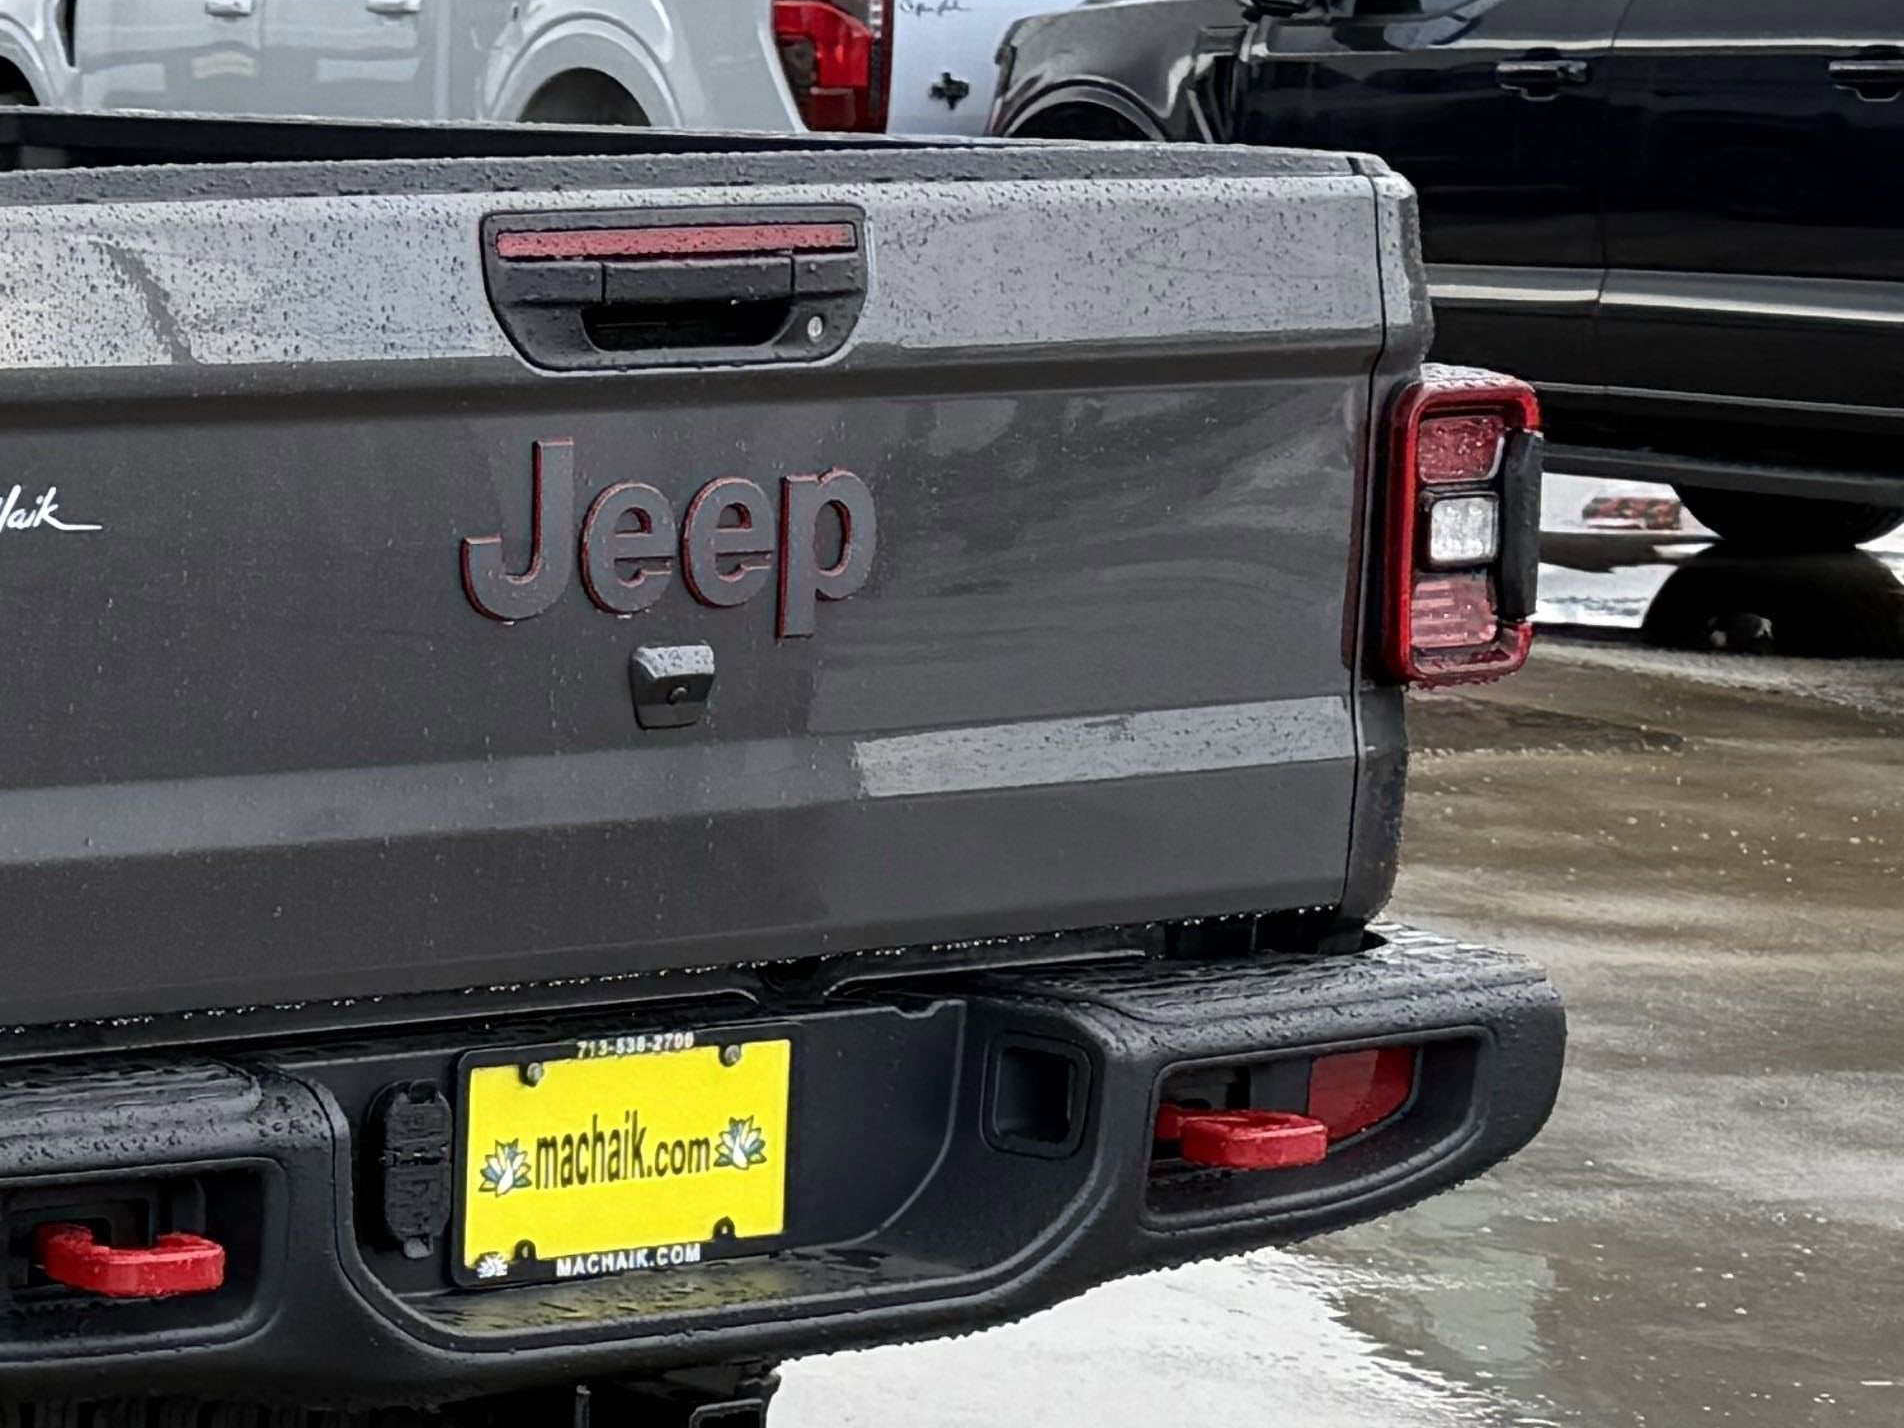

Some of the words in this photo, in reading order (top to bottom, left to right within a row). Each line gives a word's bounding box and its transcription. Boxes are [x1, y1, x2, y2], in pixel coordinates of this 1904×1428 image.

[460, 436, 878, 642] Jeep
[535, 1109, 711, 1190] machaik.com
[556, 1243, 701, 1277] MACHAIK.COM
